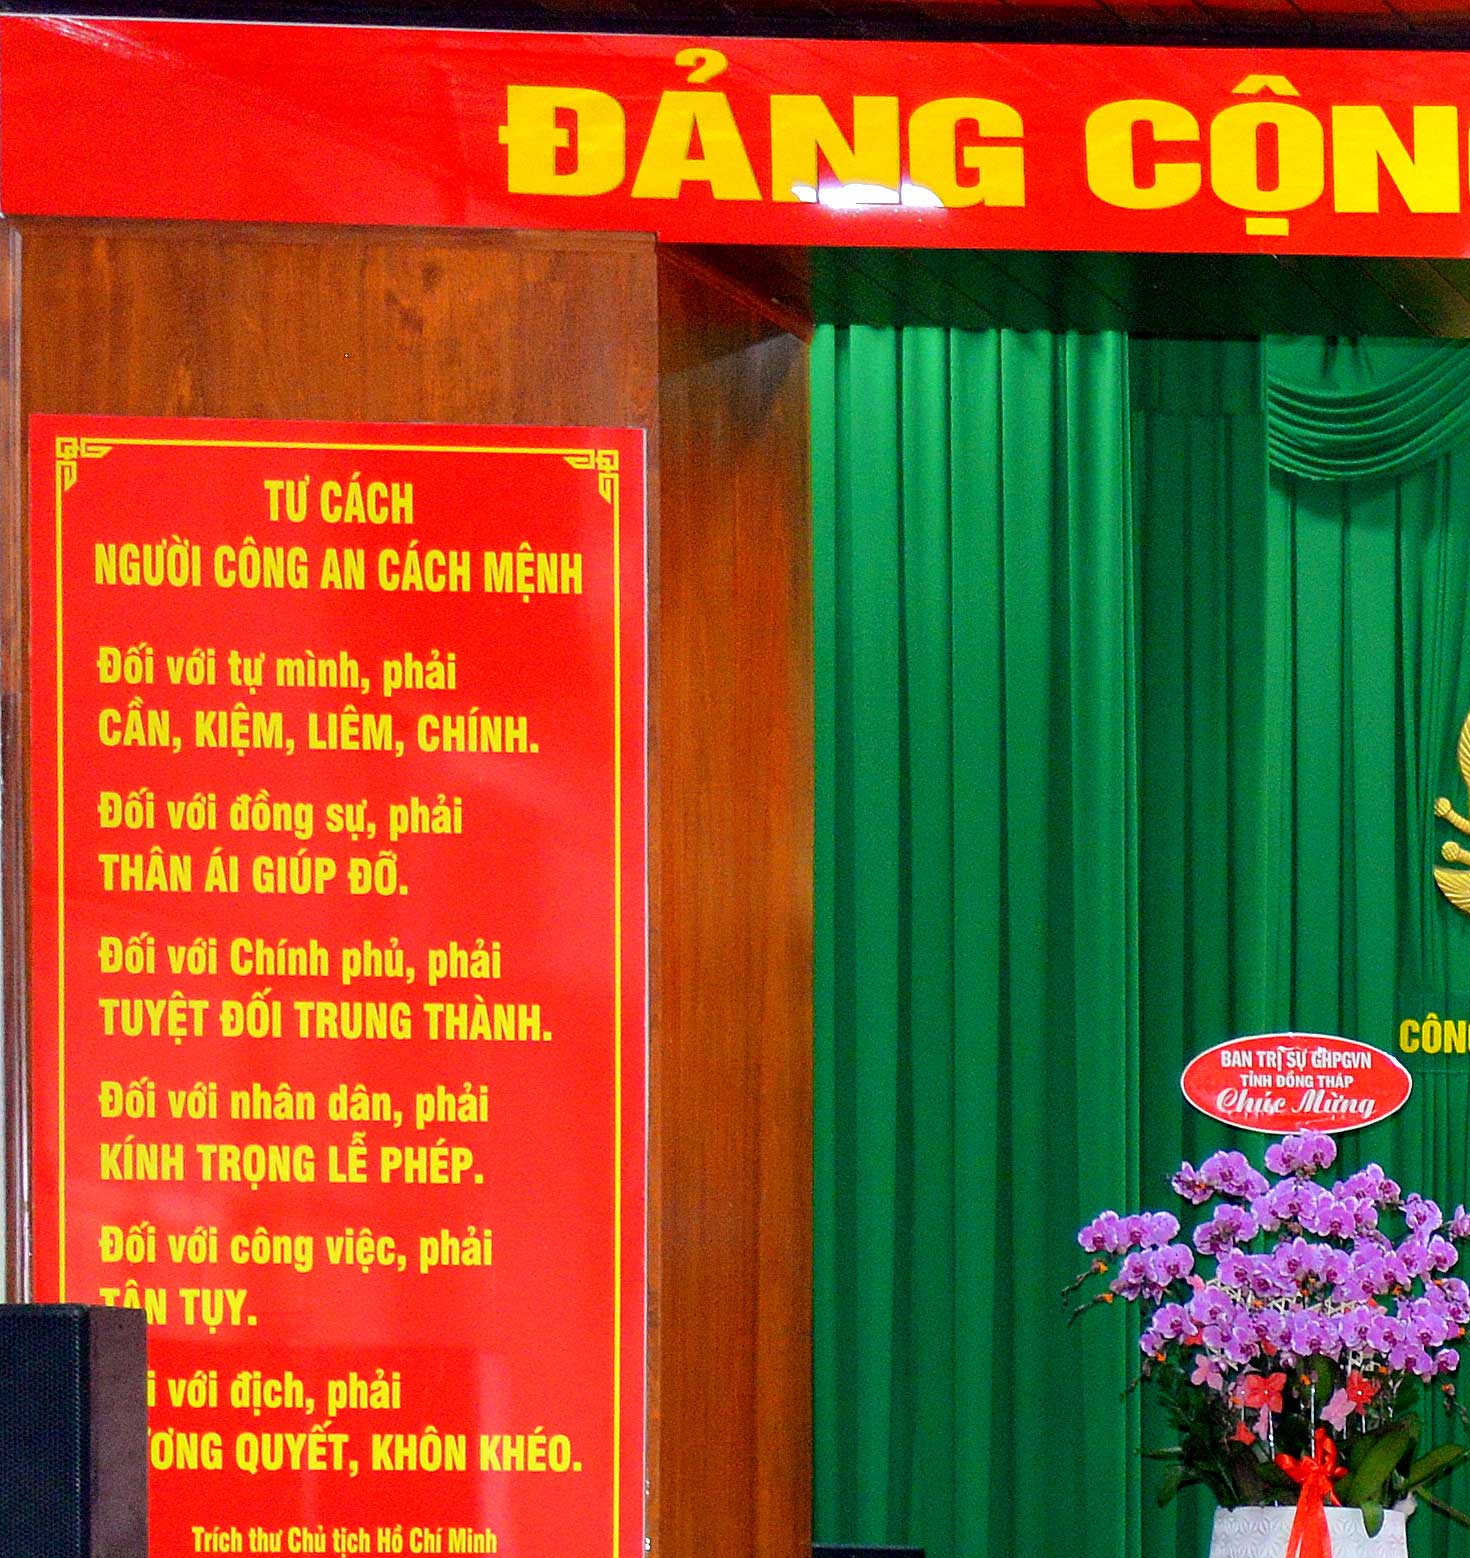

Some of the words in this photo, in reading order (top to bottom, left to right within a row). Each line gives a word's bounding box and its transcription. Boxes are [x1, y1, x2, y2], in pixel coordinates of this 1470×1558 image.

[499, 48, 1024, 207] ĐẢNG
[264, 475, 309, 522] TƯ
[321, 472, 412, 524] CÁCH
[96, 535, 200, 586] NGƯỜI
[215, 537, 308, 588] CÔNG
[321, 549, 364, 589] AN
[379, 540, 470, 592] CÁCH
[485, 542, 582, 602] MỆNH
[97, 643, 153, 683] Đối
[167, 648, 215, 685] với
[228, 651, 265, 694] tự
[277, 650, 369, 694] mình,
[384, 650, 455, 696] phải
[99, 697, 181, 753] CẦN,
[196, 703, 294, 756] KIỆM,
[309, 705, 404, 757] LIÊM,
[418, 707, 538, 752] CHÍNH.
[98, 788, 154, 828] Đối
[167, 793, 216, 830] với
[230, 789, 313, 840] đồng
[326, 800, 375, 840] sự,
[390, 794, 462, 841] phải
[99, 846, 191, 891] THÂN
[205, 847, 238, 892] ÁI
[253, 848, 336, 894] GIÚP
[348, 851, 408, 895] ĐỠ.
[98, 932, 154, 973] Đối
[168, 938, 216, 974] với
[231, 938, 328, 976] Chính
[343, 938, 414, 984] phủ,
[429, 939, 500, 986] phải
[99, 991, 209, 1044] TUYỆT
[220, 988, 281, 1037] ĐỐI
[294, 1002, 411, 1039] TRUNG
[424, 995, 552, 1041] THÀNH.
[1221, 1050, 1252, 1067] BAN
[1256, 1050, 1282, 1072] TRỊ
[1286, 1048, 1306, 1071] SỰ
[1241, 1071, 1272, 1087] TỈNH
[1277, 1070, 1313, 1088] ĐỒNG
[1318, 1072, 1354, 1088] THÁP
[1215, 1088, 1286, 1114] Chúc
[1291, 1090, 1376, 1118] Mừng
[192, 1527, 242, 1552] Trích
[249, 1527, 282, 1552] thư
[288, 1526, 325, 1552] Chủ
[333, 1528, 370, 1558] tịch
[378, 1525, 402, 1552] Hồ
[410, 1528, 442, 1553] Chí
[449, 1528, 497, 1553] Minh
